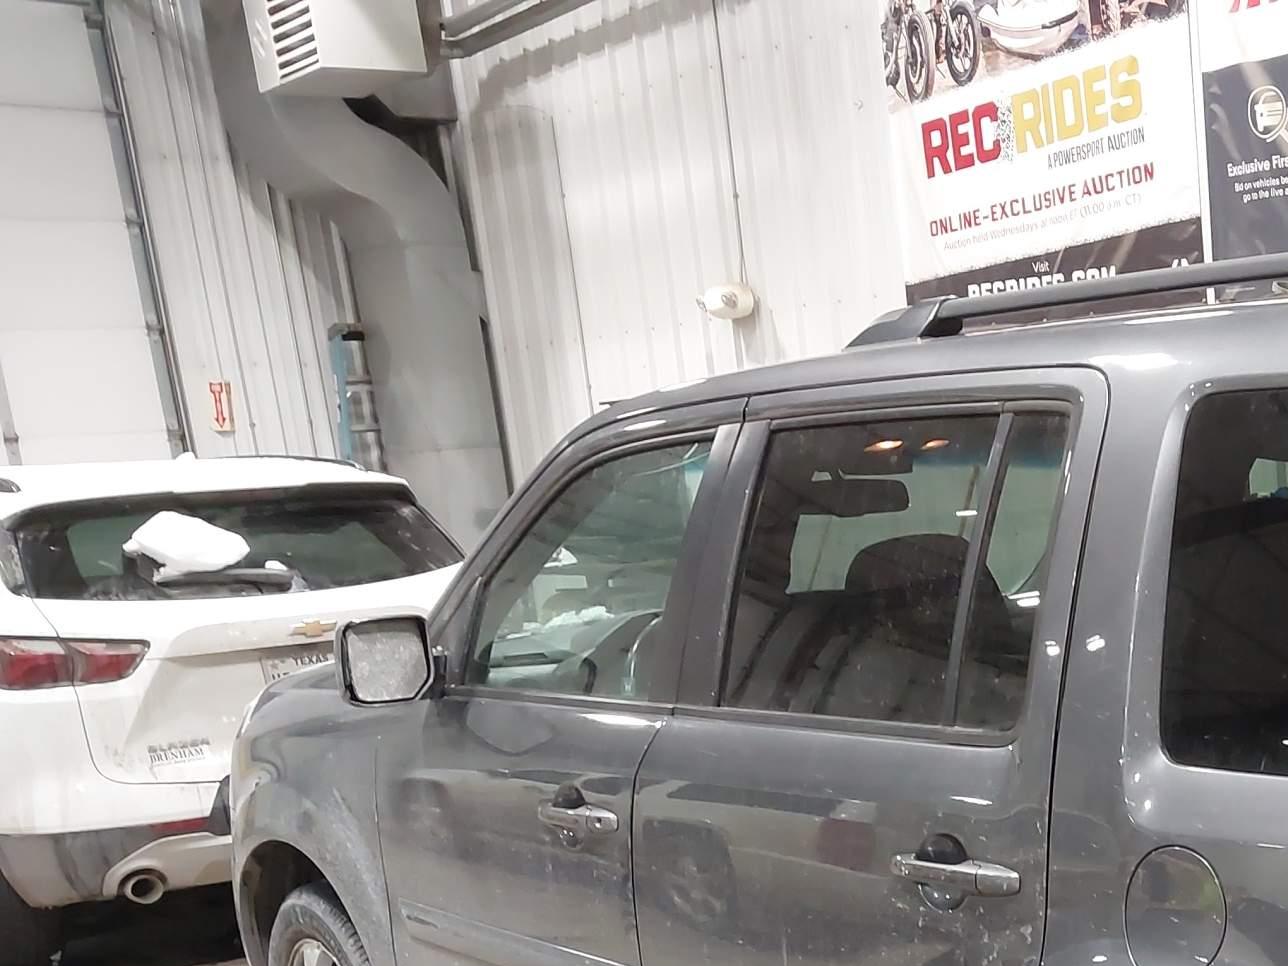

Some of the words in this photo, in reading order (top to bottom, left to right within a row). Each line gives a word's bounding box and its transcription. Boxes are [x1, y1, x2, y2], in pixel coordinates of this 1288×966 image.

[921, 101, 1001, 179] REC
[1011, 55, 1143, 153] RIDES
[1053, 137, 1105, 168] POWERSPORT
[1107, 126, 1145, 153] AUCTION
[1227, 158, 1270, 177] Exclusive
[1234, 182, 1244, 192] Bid
[1244, 181, 1252, 189] on
[1252, 177, 1280, 189] vehicles
[929, 183, 1076, 237] ONLINE-EXCLUSIVE
[1081, 161, 1154, 198] AUCTION
[1243, 193, 1251, 203] go
[1252, 192, 1258, 200] to
[1258, 190, 1269, 199] the
[1270, 188, 1283, 197] live
[944, 239, 971, 252] Auction
[1032, 261, 1050, 273] Visit
